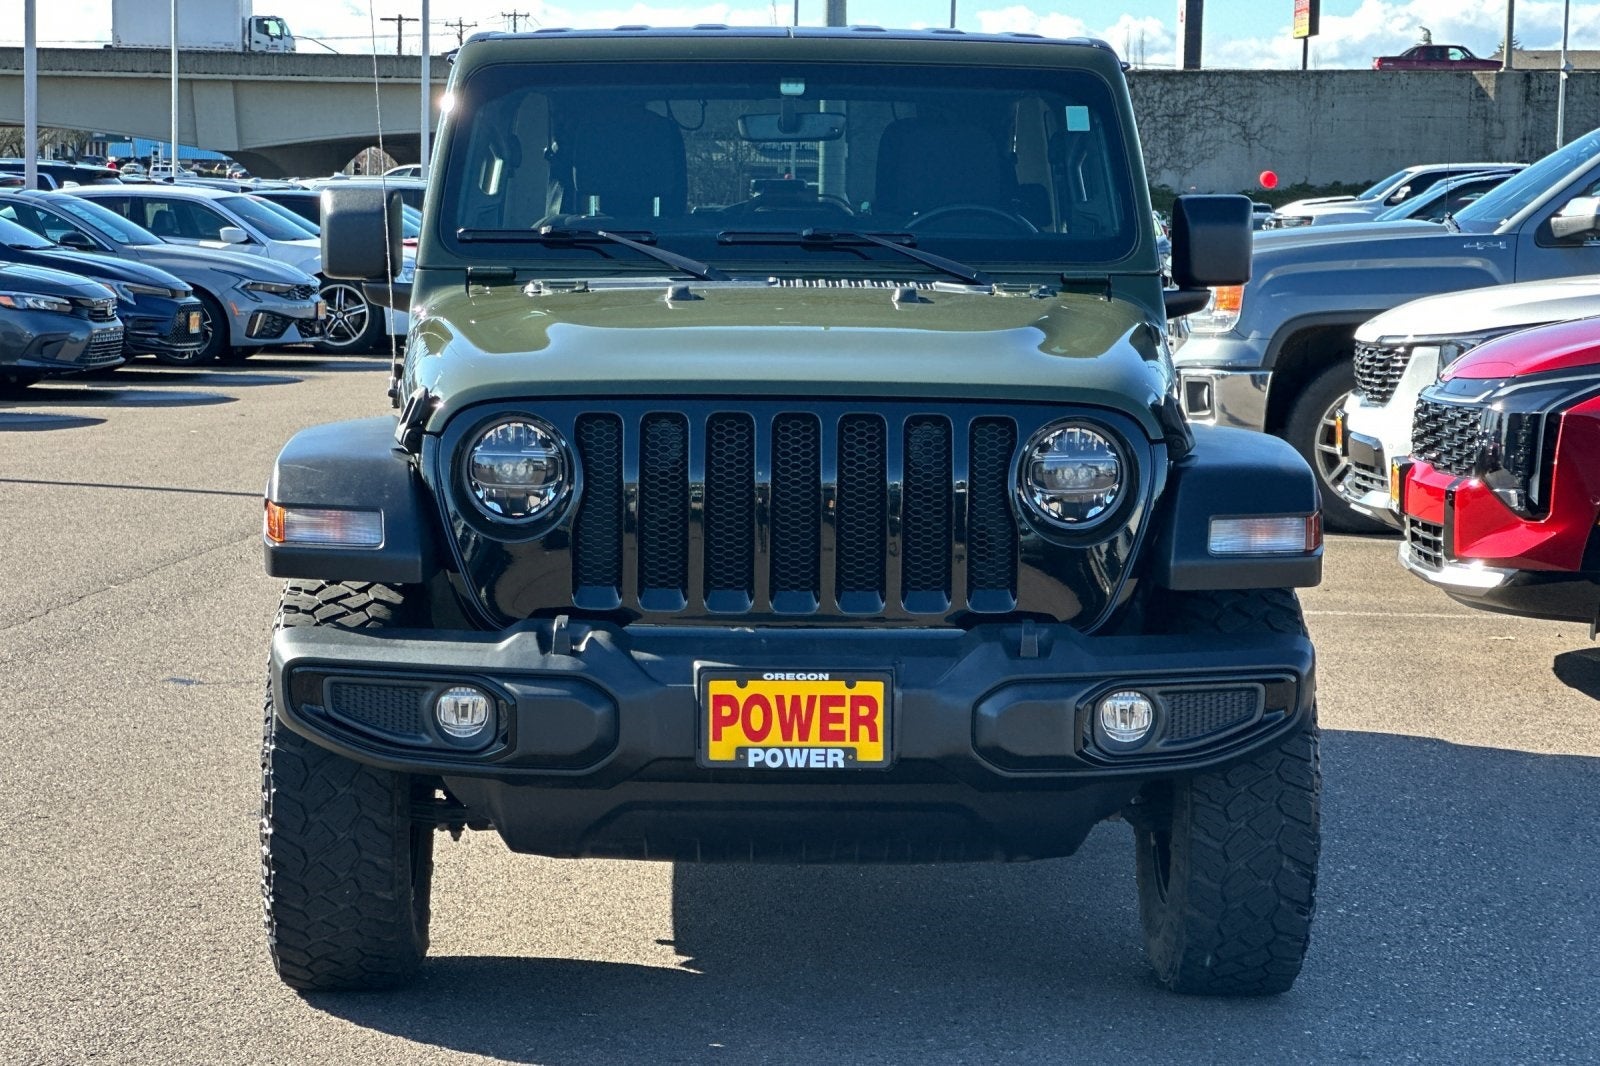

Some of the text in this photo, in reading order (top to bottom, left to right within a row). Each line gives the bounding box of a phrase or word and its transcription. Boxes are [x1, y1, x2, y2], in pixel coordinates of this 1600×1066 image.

[762, 672, 830, 681] OREGON
[712, 693, 879, 743] POWER
[747, 747, 845, 769] POWER
